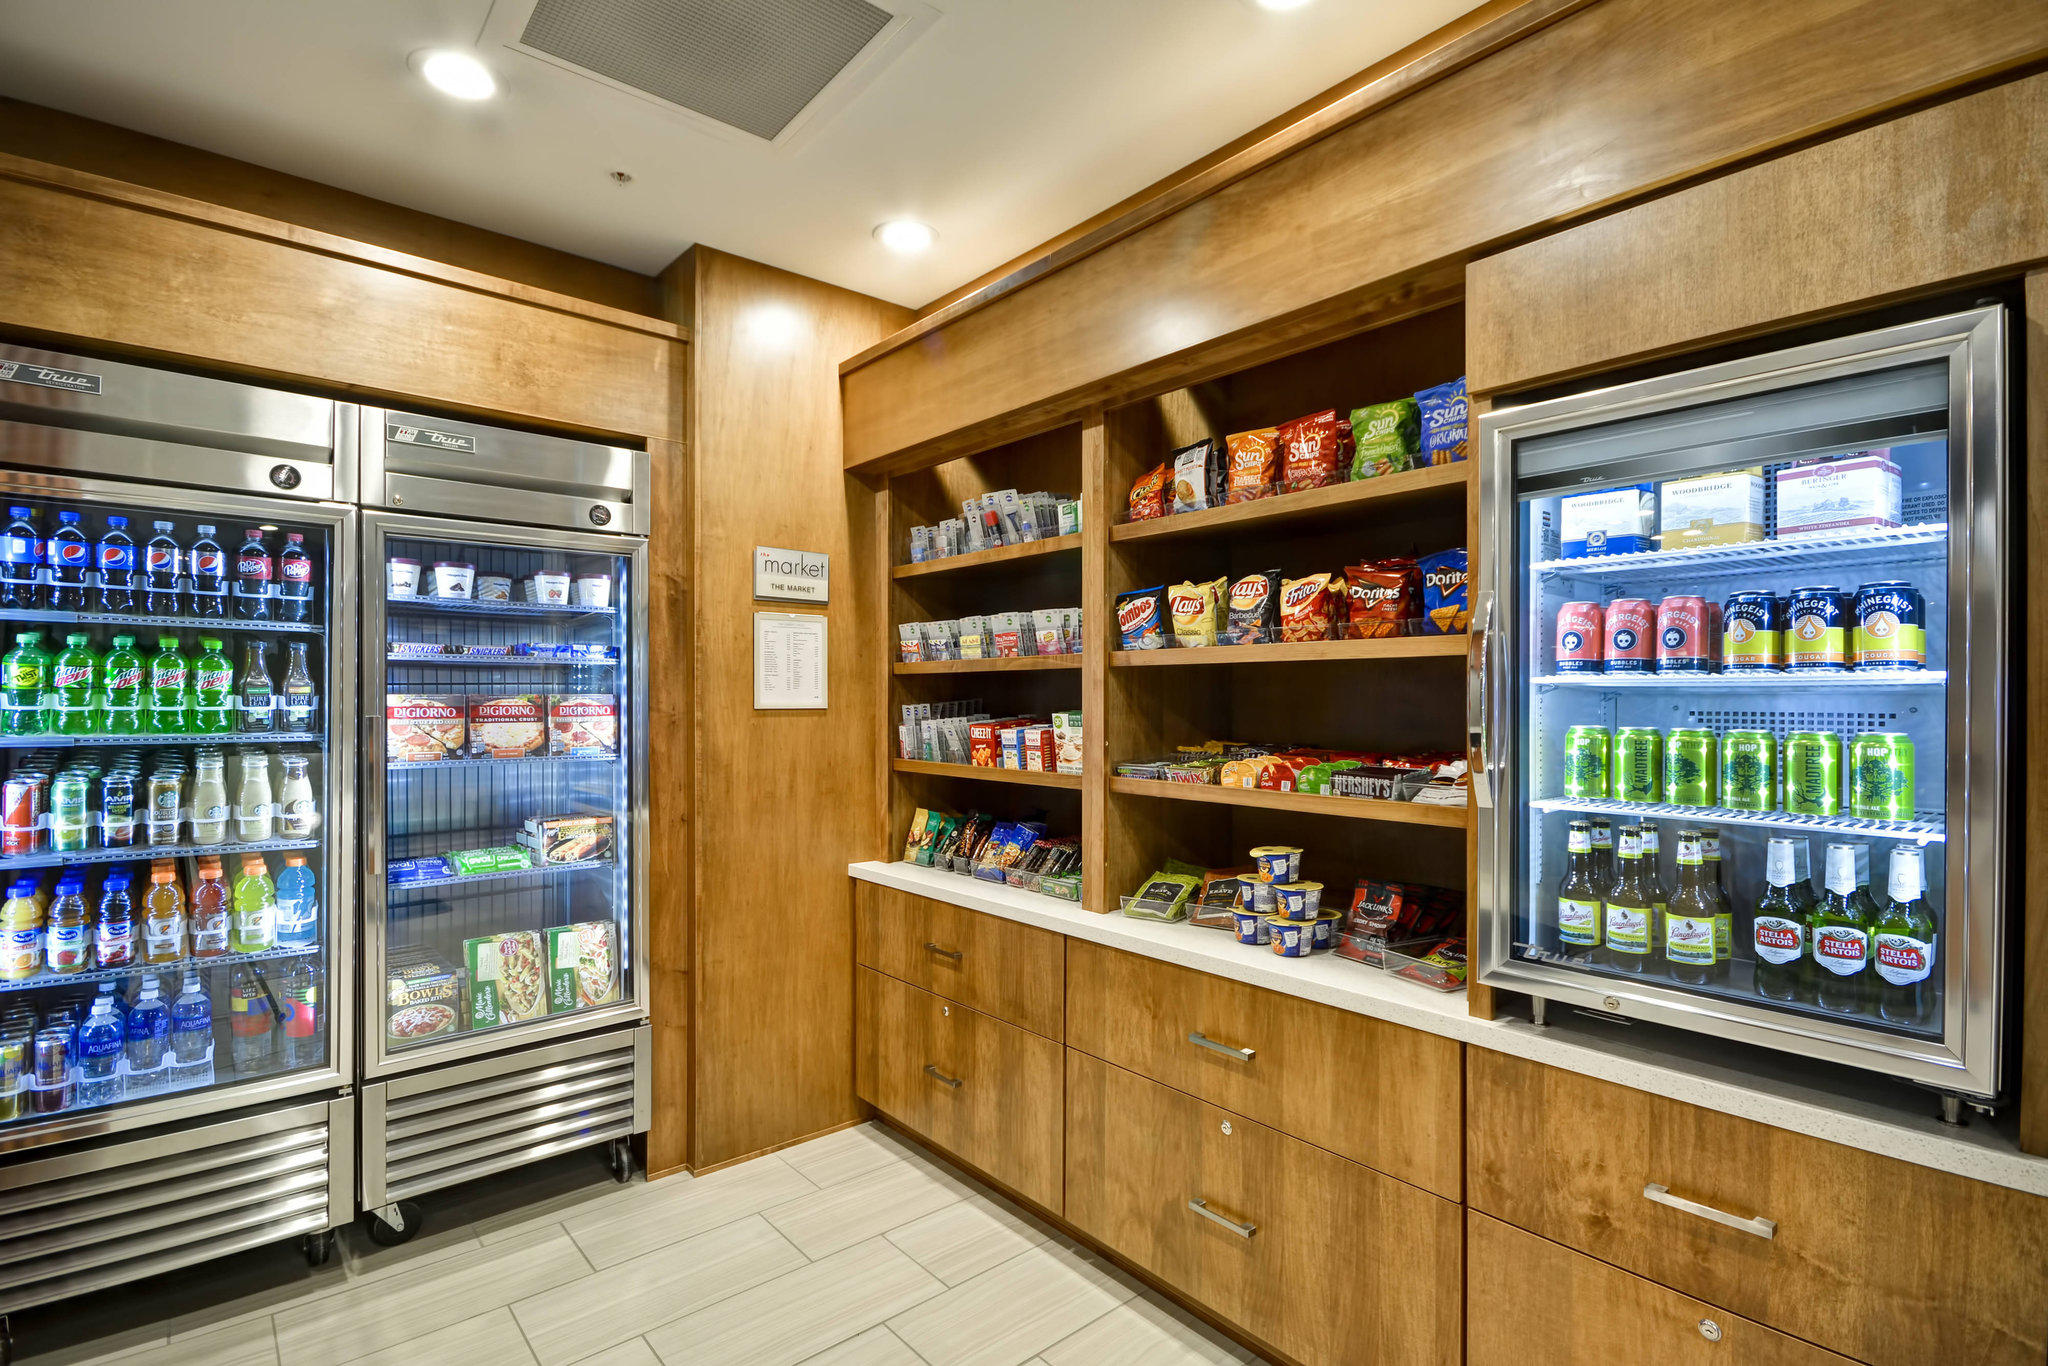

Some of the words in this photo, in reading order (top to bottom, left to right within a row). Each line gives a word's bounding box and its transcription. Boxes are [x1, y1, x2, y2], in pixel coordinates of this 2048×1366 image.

[1429, 402, 1468, 427] Sun
[1361, 415, 1398, 442] Sun
[1289, 438, 1320, 462] Sun
[1235, 448, 1264, 470] Sun
[1801, 473, 1848, 485] BERINGER
[1672, 483, 1733, 496] WOODBRIDGE
[1571, 498, 1625, 508] WOODBRIDGE
[239, 561, 262, 573] Pepper
[764, 553, 825, 579] market
[771, 583, 785, 591] THE
[787, 585, 815, 594] MARKET
[1231, 580, 1266, 599] Lay's
[1286, 582, 1320, 607] Fritos
[1349, 585, 1400, 600] Doritos
[1172, 596, 1203, 616] Lay's
[1229, 611, 1260, 620] Barbecue
[1177, 628, 1202, 636] Classic
[401, 644, 441, 654] SNICKERS
[470, 646, 507, 656] SNICKERS
[15, 669, 38, 682] TWIST
[1867, 748, 1888, 757] HOP
[1634, 740, 1648, 784] MADTREE
[1806, 745, 1821, 794] MADTREE
[1335, 774, 1390, 798] HERSHEY'S
[1358, 901, 1373, 910] JACK
[1373, 902, 1393, 914] LINK'S
[1759, 930, 1793, 940] STELLA
[1759, 937, 1794, 947] ARTOIS
[1824, 940, 1860, 950] STELLA
[1823, 947, 1860, 957] ARTOIS
[1880, 947, 1917, 959] STELLA
[1880, 955, 1918, 967] ARTOIS
[398, 985, 453, 1006] BOWLS
